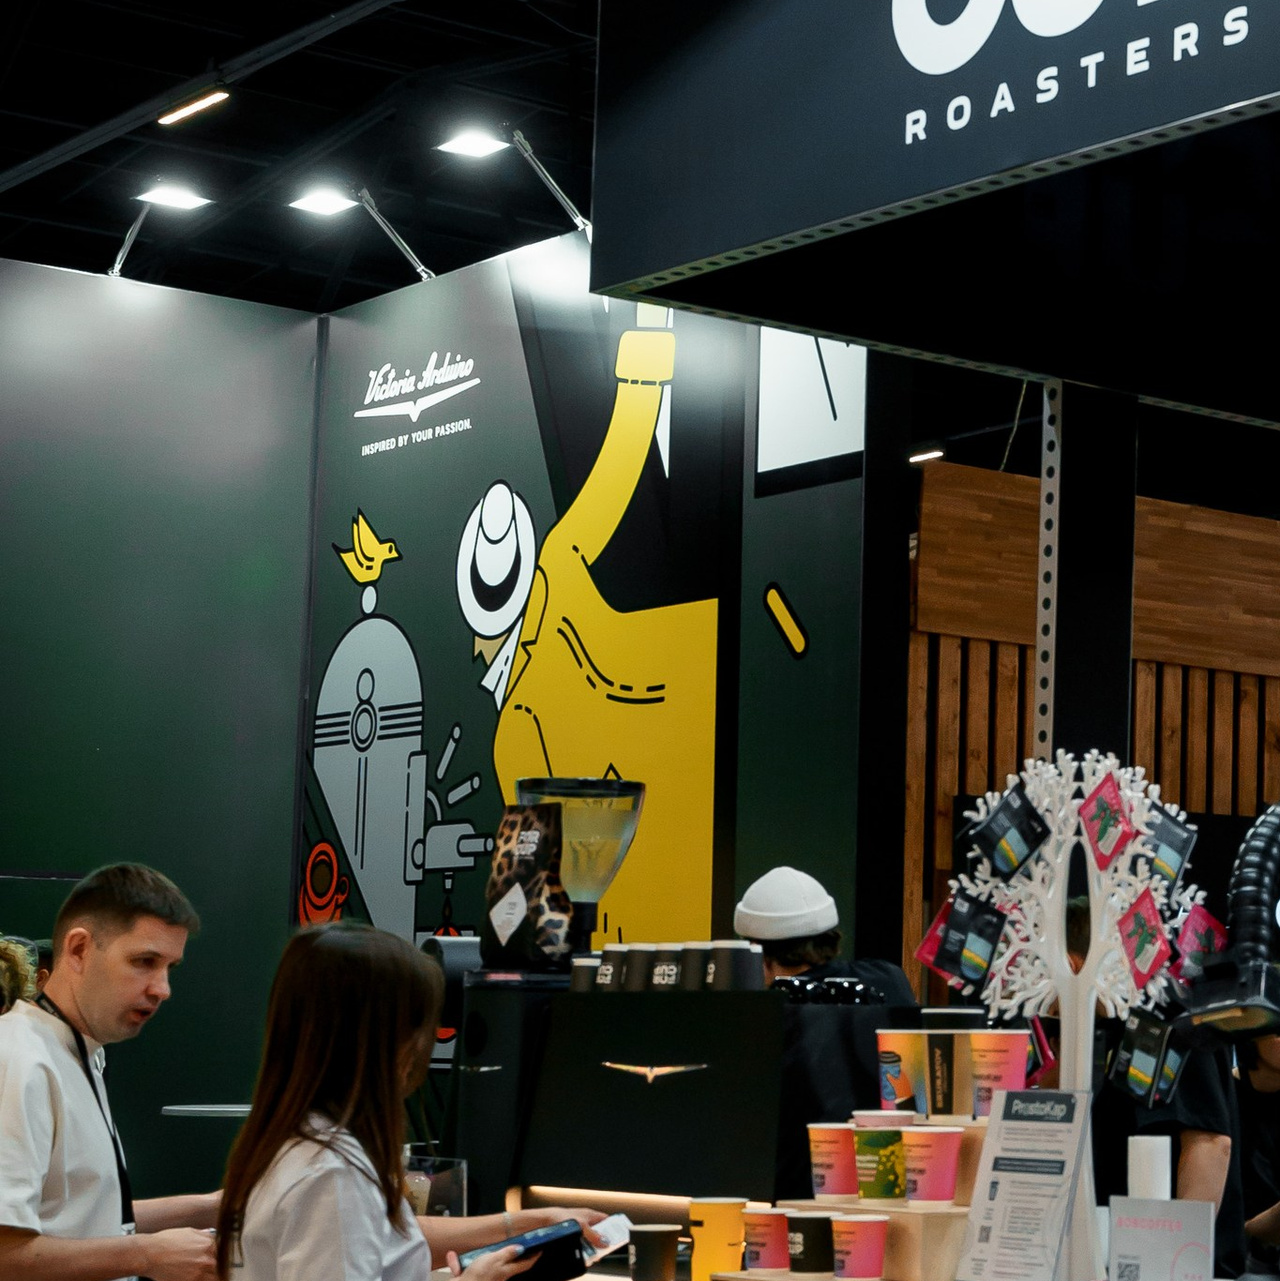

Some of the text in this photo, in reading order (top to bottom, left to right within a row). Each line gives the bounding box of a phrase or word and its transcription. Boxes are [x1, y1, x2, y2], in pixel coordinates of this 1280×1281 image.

[905, 5, 1250, 145] ROASTERS
[364, 351, 474, 405] Victoria Arduino
[361, 418, 472, 456] INSPIRED BY YOUR PASSION.
